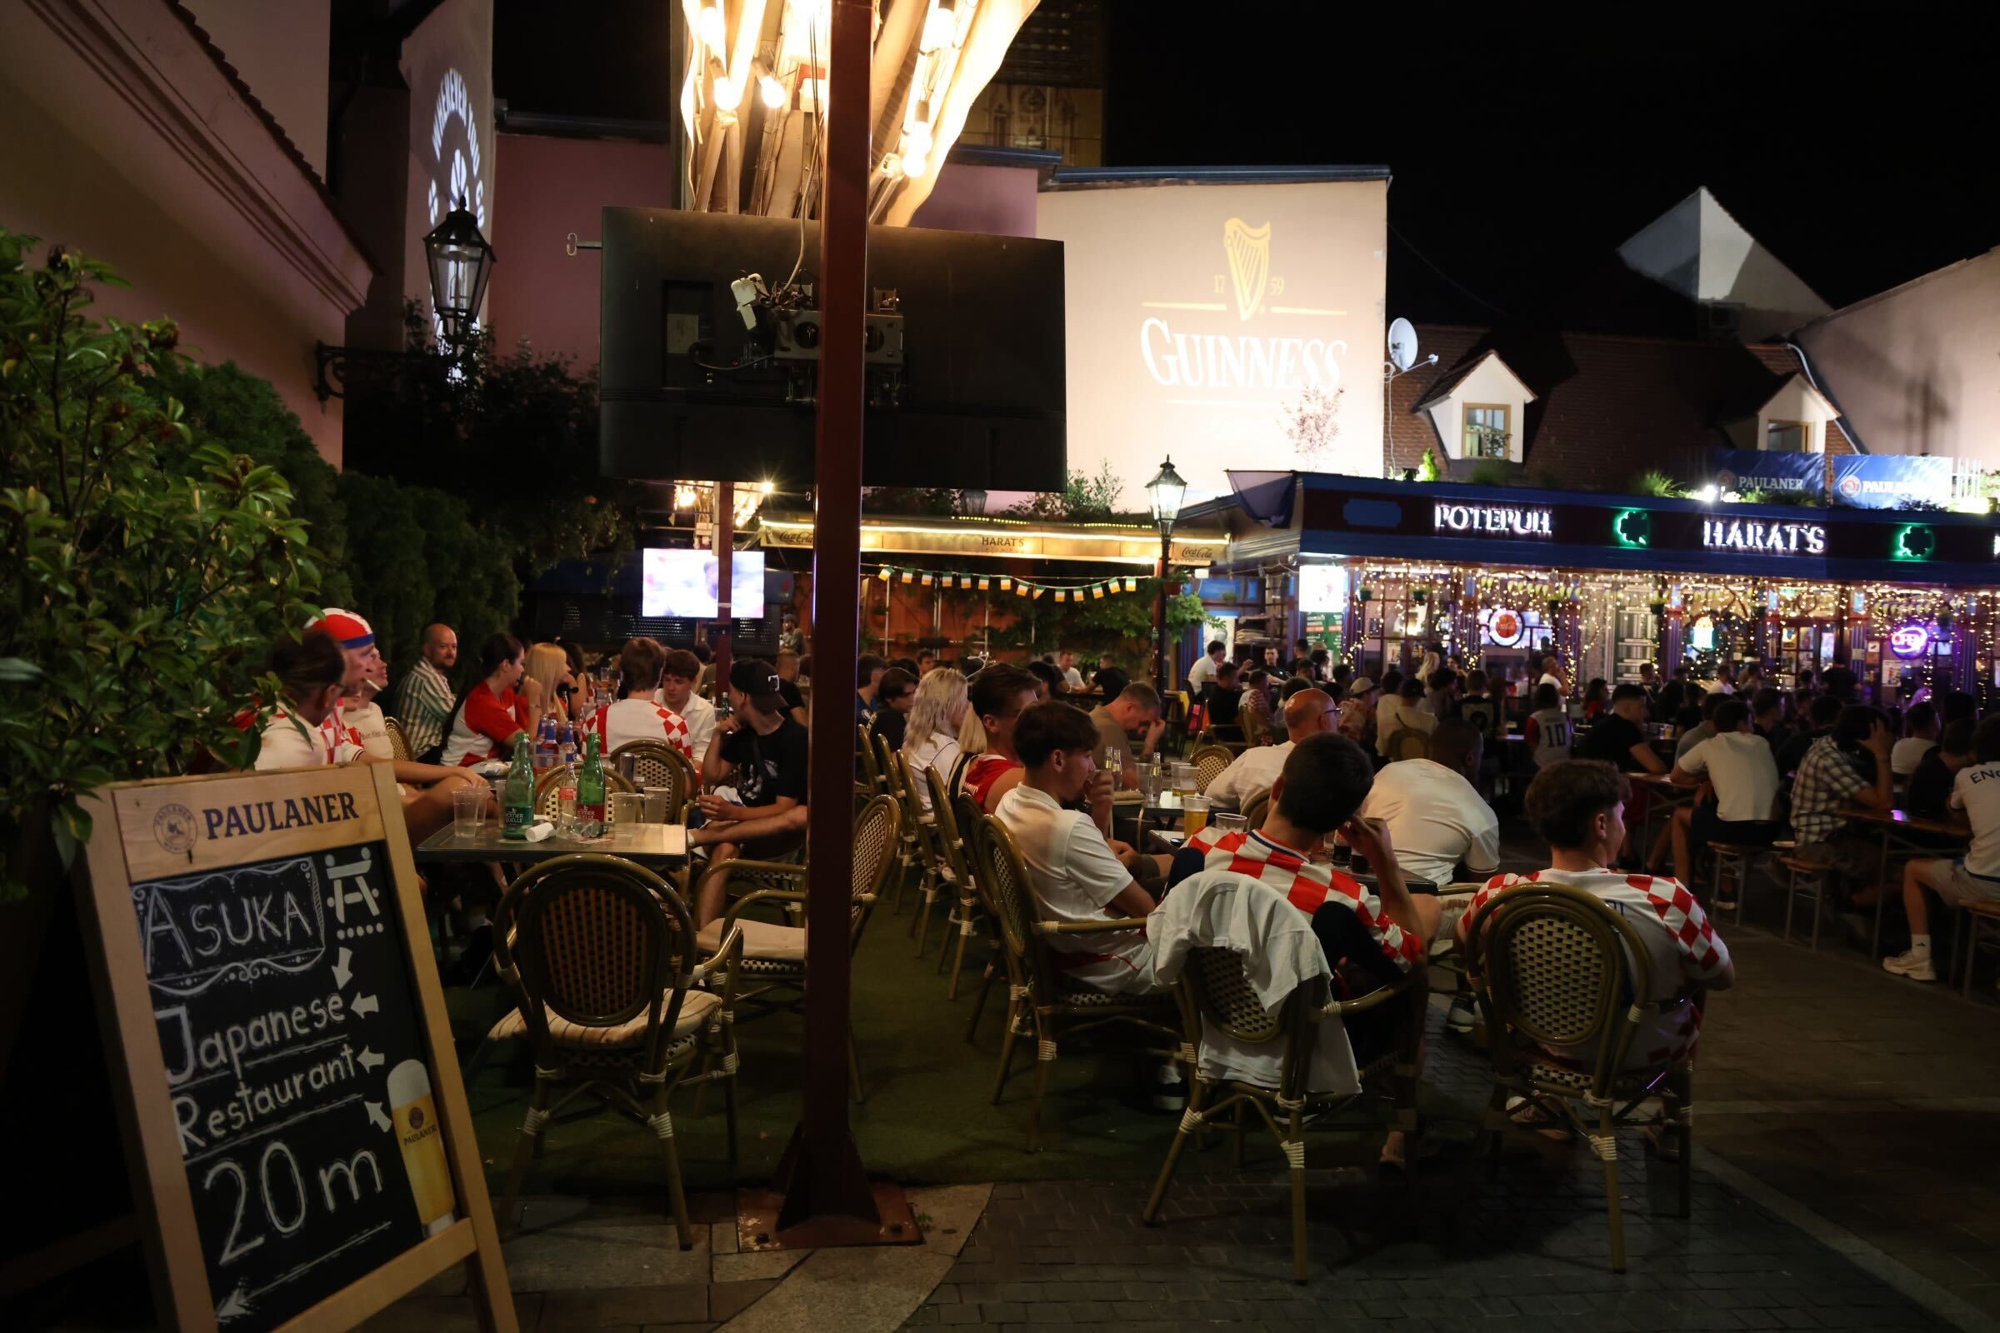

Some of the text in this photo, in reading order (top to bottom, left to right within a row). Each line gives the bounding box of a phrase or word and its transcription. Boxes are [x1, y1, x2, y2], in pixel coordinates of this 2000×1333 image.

[1214, 274, 1285, 295] 17 59
[1140, 316, 1347, 392] GUINNESS
[1738, 475, 1804, 491] PAULANER
[1434, 504, 1553, 535] POTEPUH
[1703, 519, 1826, 554] HARAT'S
[1545, 723, 1567, 747] 10
[202, 791, 360, 841] PAULANER
[145, 884, 314, 974] ASUKA
[154, 992, 346, 1086] Japanese
[171, 1042, 356, 1156] Restaurant
[204, 1139, 385, 1267] 20 m
